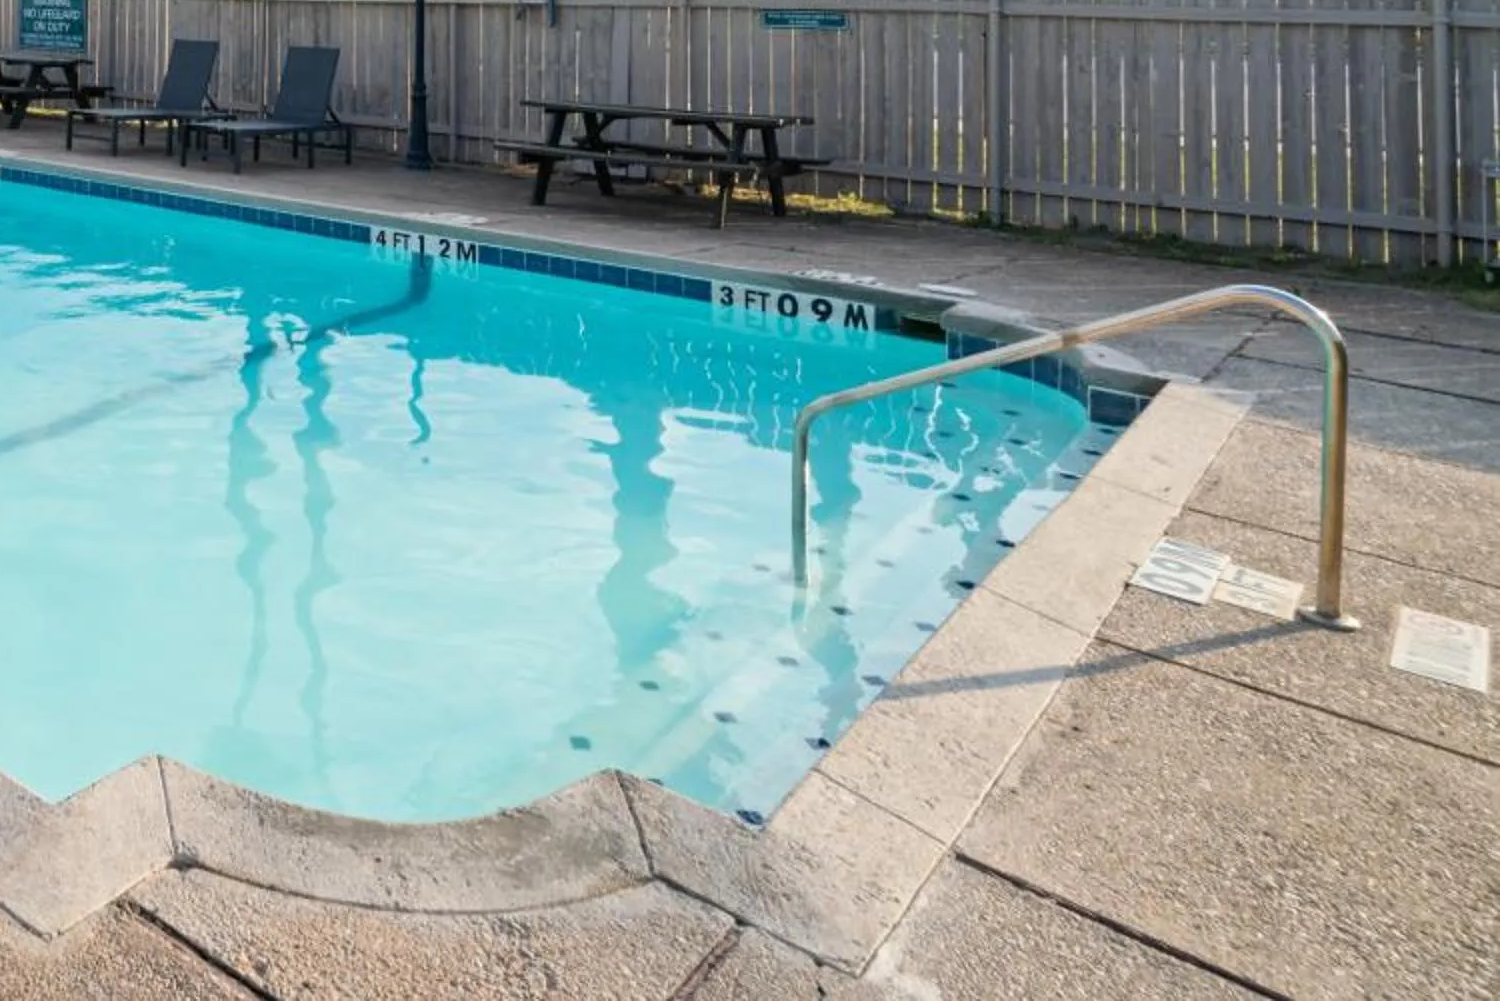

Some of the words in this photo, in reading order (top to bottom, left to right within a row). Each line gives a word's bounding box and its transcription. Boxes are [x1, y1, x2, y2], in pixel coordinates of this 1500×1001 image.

[376, 230, 387, 248] 4
[393, 232, 412, 250] FT
[719, 286, 734, 307] 3
[744, 290, 771, 312] FT
